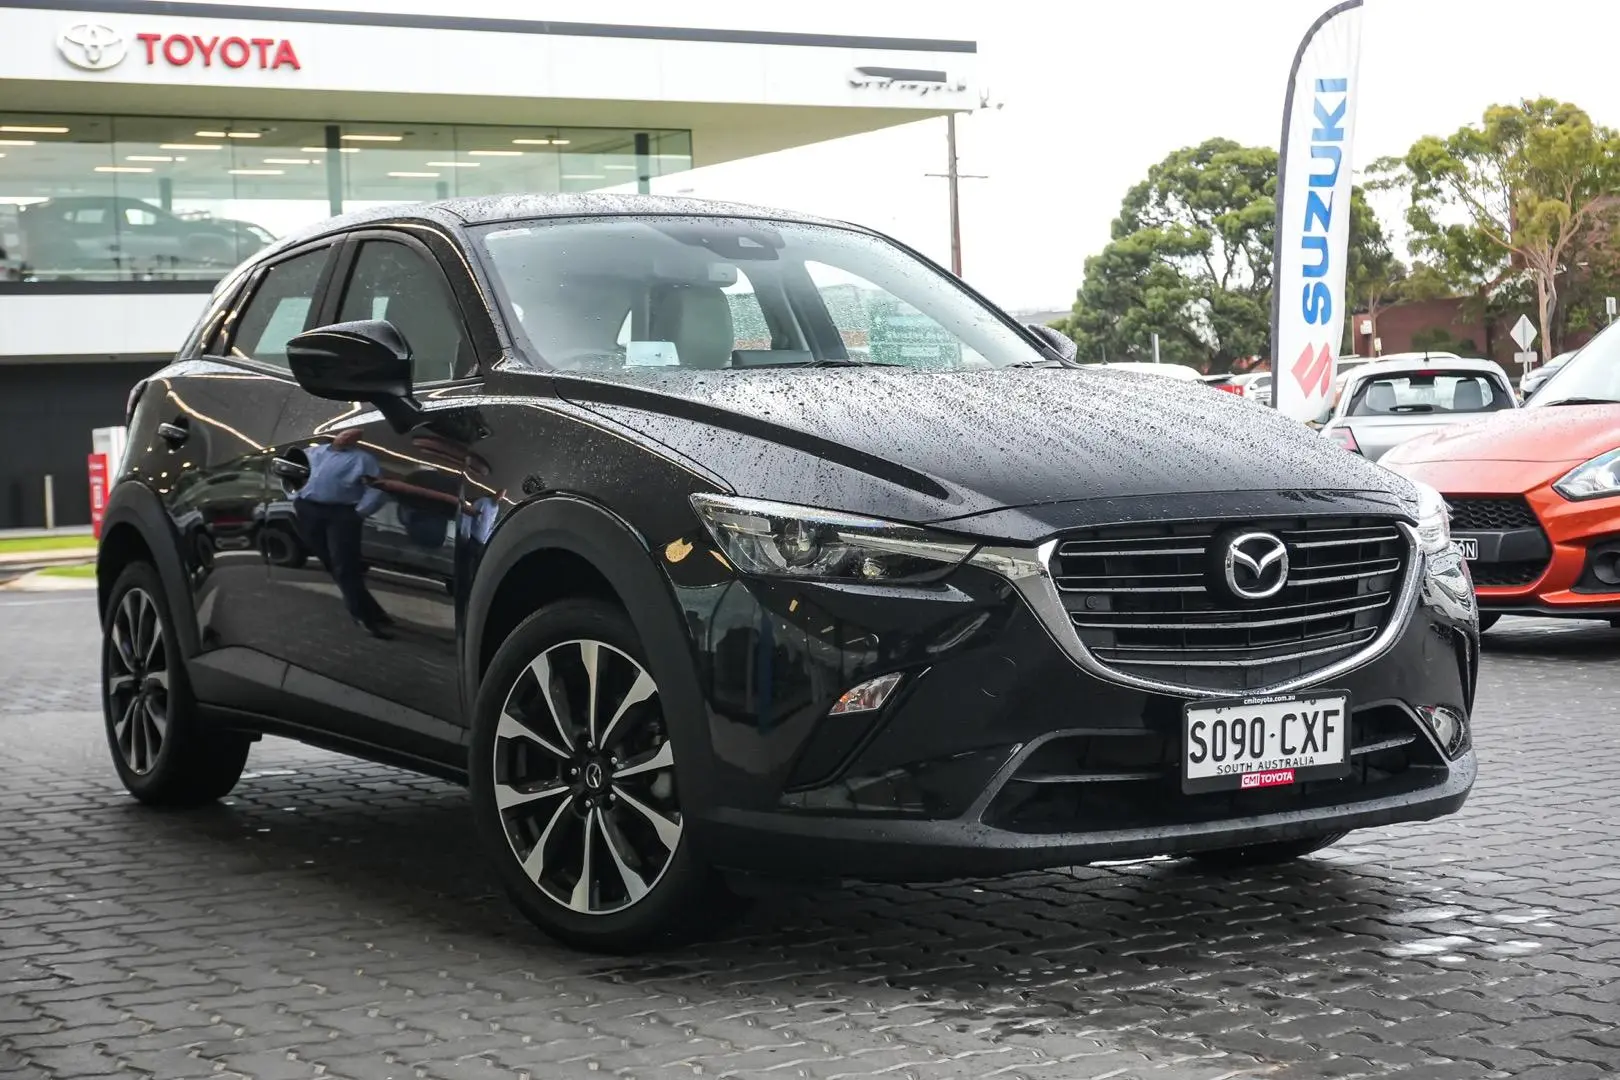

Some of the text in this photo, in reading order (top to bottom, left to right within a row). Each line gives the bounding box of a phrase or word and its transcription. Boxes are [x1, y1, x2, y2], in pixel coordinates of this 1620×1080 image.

[136, 33, 301, 71] TOYOTA
[1301, 78, 1348, 326] SUZUKI
[1243, 694, 1296, 705] cmitoyota.com.au
[1216, 756, 1315, 775] SOUTH AUSTRALIA
[1260, 771, 1294, 784] TOYOTA
